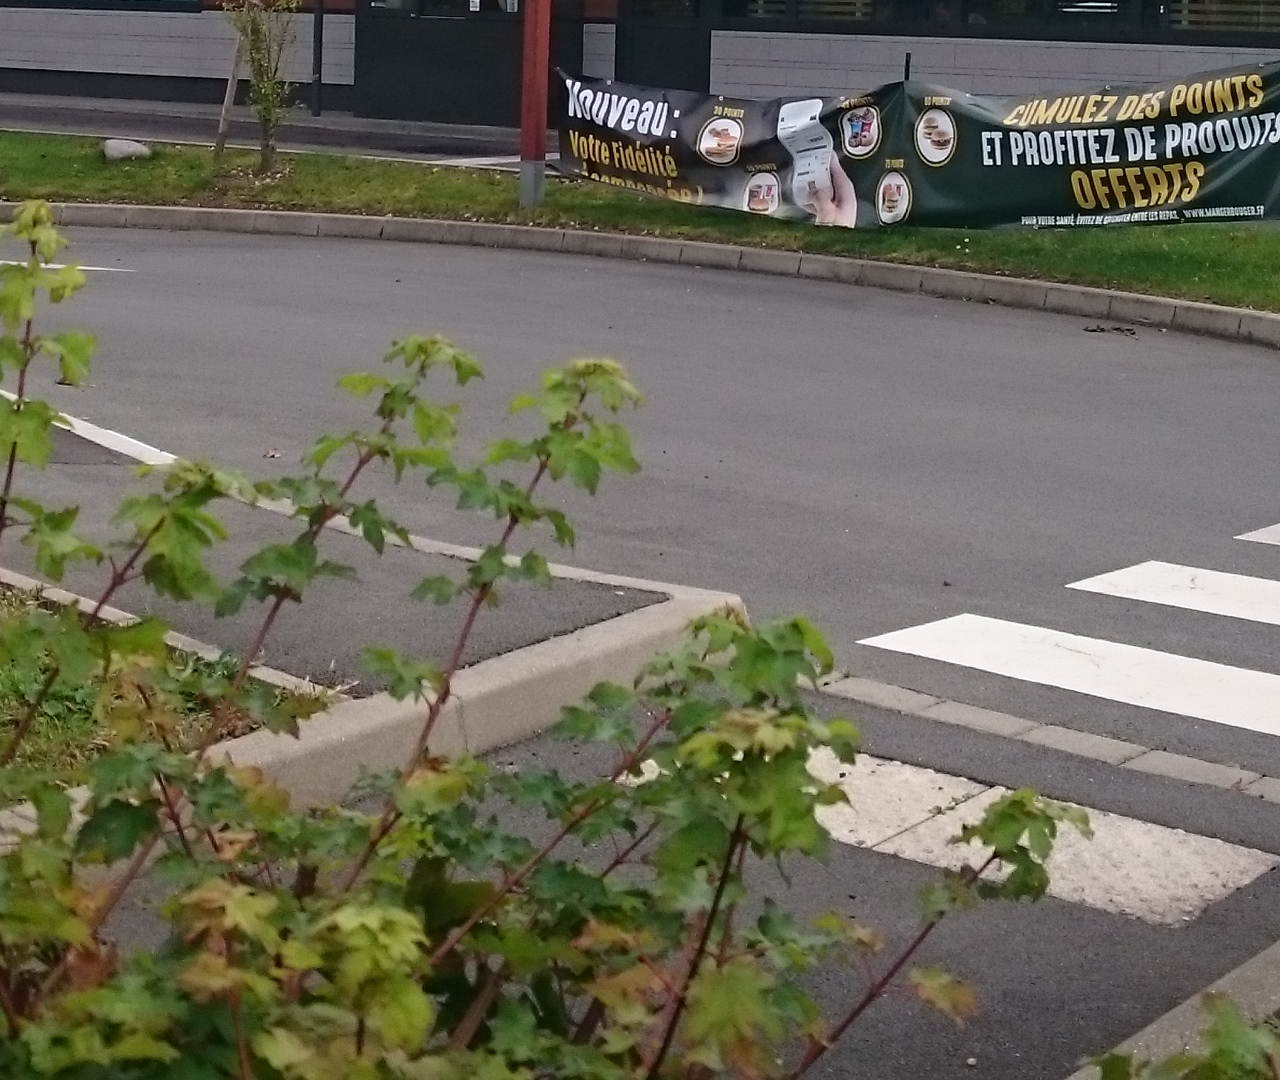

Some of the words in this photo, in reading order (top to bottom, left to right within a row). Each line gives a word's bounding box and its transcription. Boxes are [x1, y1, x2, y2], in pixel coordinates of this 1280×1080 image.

[723, 107, 744, 118] POINTS
[1003, 95, 1119, 127] CUMULEZ
[1116, 90, 1165, 121] DES
[1169, 73, 1265, 118] POINTS
[611, 140, 679, 179] Fidélité
[981, 131, 1003, 166] ET
[1009, 128, 1120, 166] PROFITEZ
[1124, 124, 1158, 162] DE
[1070, 161, 1204, 210] OFFERTS
[1149, 211, 1158, 221] LES
